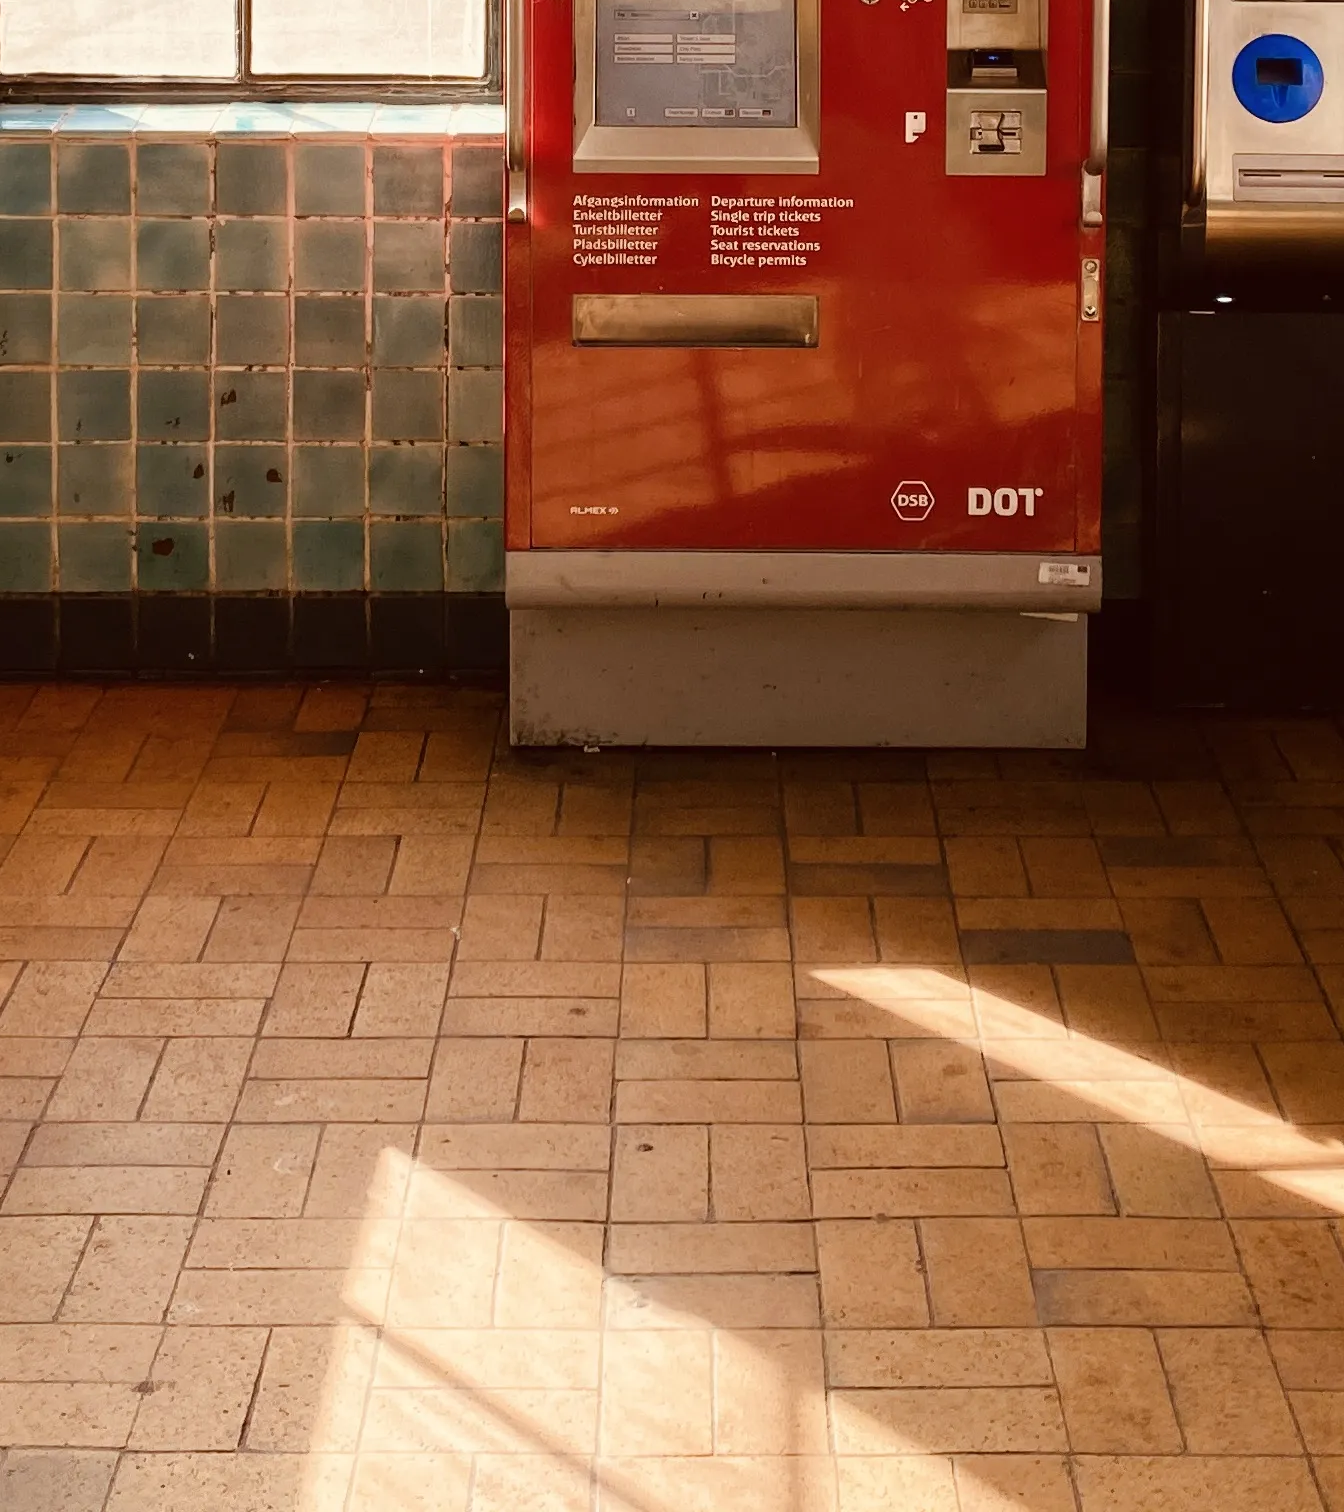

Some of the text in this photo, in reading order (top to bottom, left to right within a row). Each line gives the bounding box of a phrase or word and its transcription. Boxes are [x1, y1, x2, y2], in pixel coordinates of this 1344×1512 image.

[573, 195, 699, 208] Afgangsinformation
[711, 196, 854, 209] Departure information
[573, 210, 663, 222] Enkeltbilletter
[711, 210, 821, 224] Single trip tickets
[573, 224, 658, 236] Turistbilletter
[710, 225, 799, 237] Tourist tickets
[573, 239, 658, 250] Pladsbilletter
[710, 240, 820, 252] Seat reservations
[573, 254, 657, 266] Cykelbilletter
[711, 254, 806, 267] Bicycle permits
[898, 488, 1043, 516] DSB DOT
